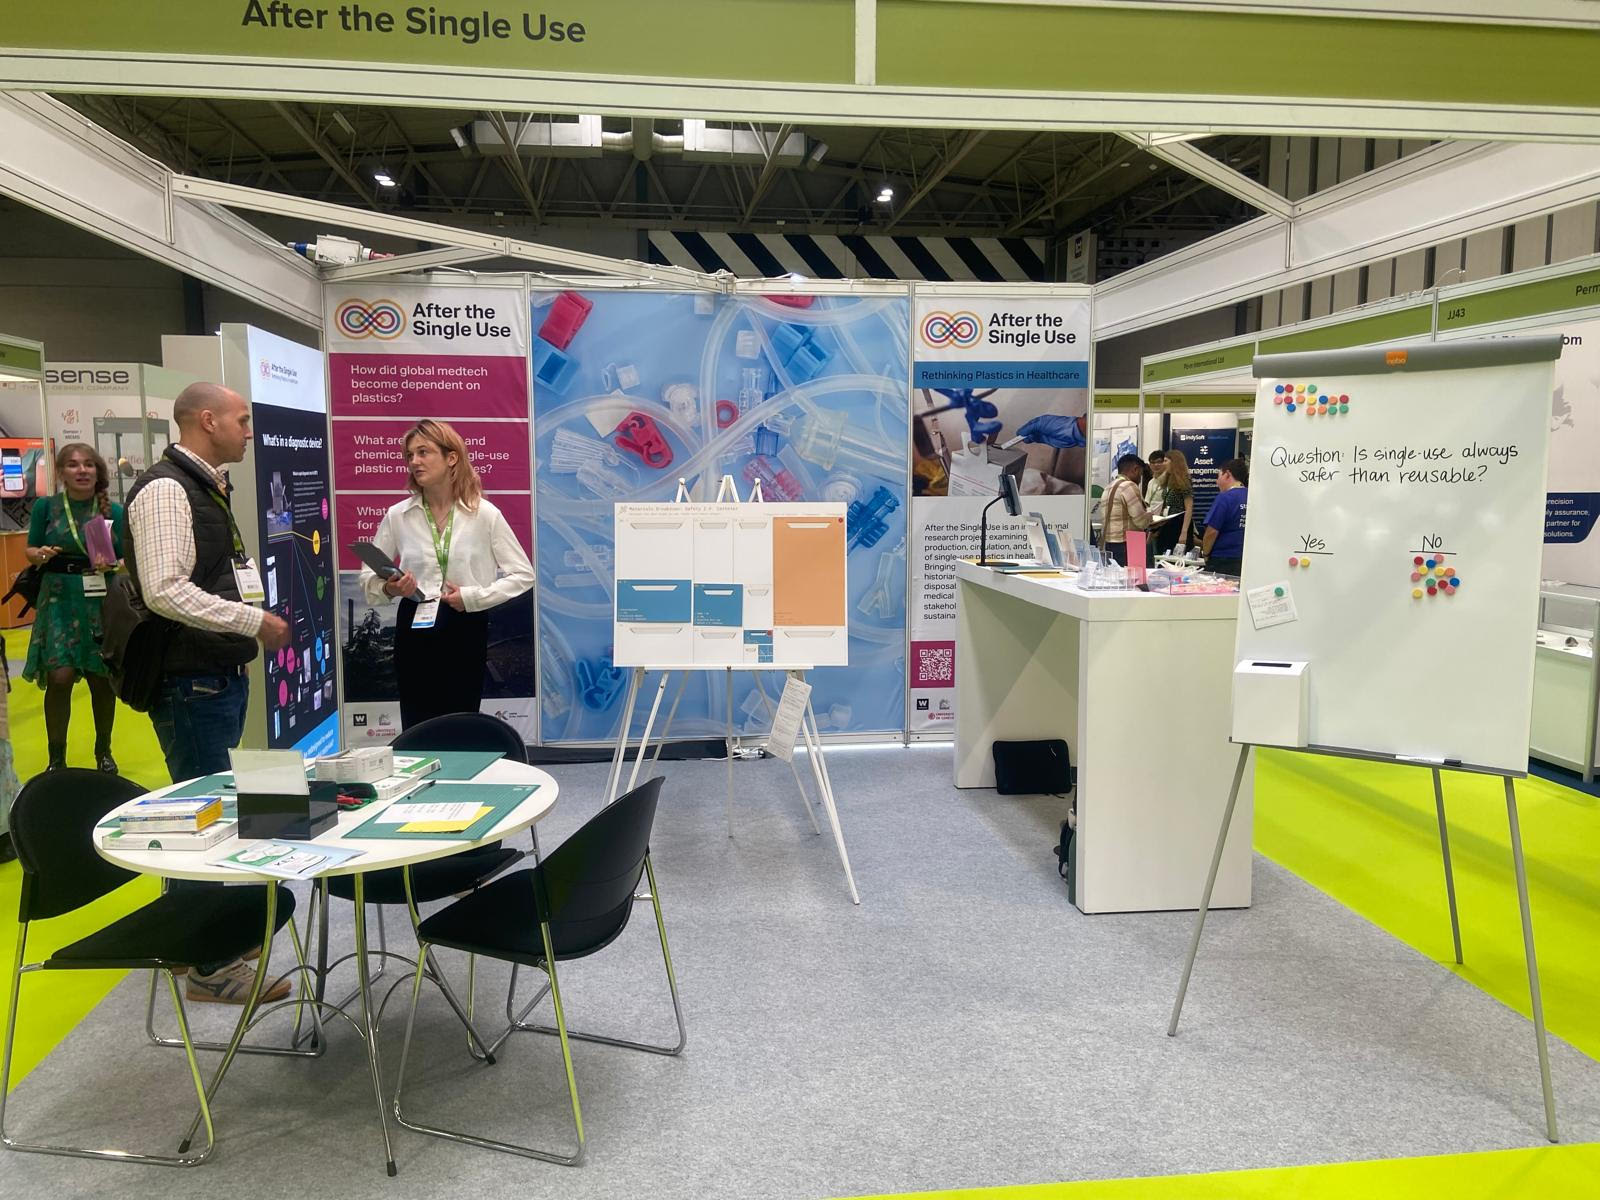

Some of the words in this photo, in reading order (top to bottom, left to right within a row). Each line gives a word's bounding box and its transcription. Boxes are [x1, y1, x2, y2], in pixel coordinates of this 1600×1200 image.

[241, 0, 328, 30] After
[338, 5, 395, 33] the
[405, 7, 511, 44] Single
[523, 13, 586, 43] Use
[412, 302, 464, 319] After
[464, 304, 496, 319] the
[1447, 308, 1466, 320] JJ43
[988, 312, 1033, 327] After
[1035, 314, 1062, 327] the
[412, 320, 472, 340] Single
[476, 322, 511, 338] Use
[988, 330, 1042, 347] Single
[1044, 330, 1076, 344] Use
[350, 364, 376, 375] How
[379, 365, 397, 375] did
[400, 366, 435, 377] global
[437, 366, 488, 376] medtech
[922, 370, 973, 382] Rethinking
[976, 370, 1014, 380] Plastics
[1016, 370, 1024, 380] in
[1026, 370, 1080, 380] Healthcare
[352, 379, 399, 389] become
[401, 380, 464, 391] dependent
[465, 382, 481, 390] on
[352, 392, 403, 404] plastics?
[262, 434, 280, 446] What's
[280, 434, 284, 447] in
[354, 436, 384, 446] What
[464, 436, 486, 446] and
[354, 450, 404, 460] chemica
[468, 450, 510, 462] gle-use
[1353, 445, 1368, 463] Is
[1373, 446, 1453, 468] single-use
[1461, 441, 1520, 465] always
[355, 464, 393, 476] plastic
[1188, 468, 1221, 476] anageme
[1298, 466, 1342, 484] safer
[1348, 466, 1390, 485] than
[1400, 465, 1488, 484] reusable?
[356, 506, 387, 516] What
[357, 520, 374, 530] for
[988, 534, 1028, 542] examining
[1300, 534, 1326, 552] Yes
[1422, 533, 1444, 553] No
[924, 544, 969, 552] production,
[970, 543, 1011, 551] cirulation,
[934, 554, 974, 562] single-use
[924, 564, 956, 572] Bringing
[924, 582, 957, 592] disposal
[924, 602, 956, 610] stakehol
